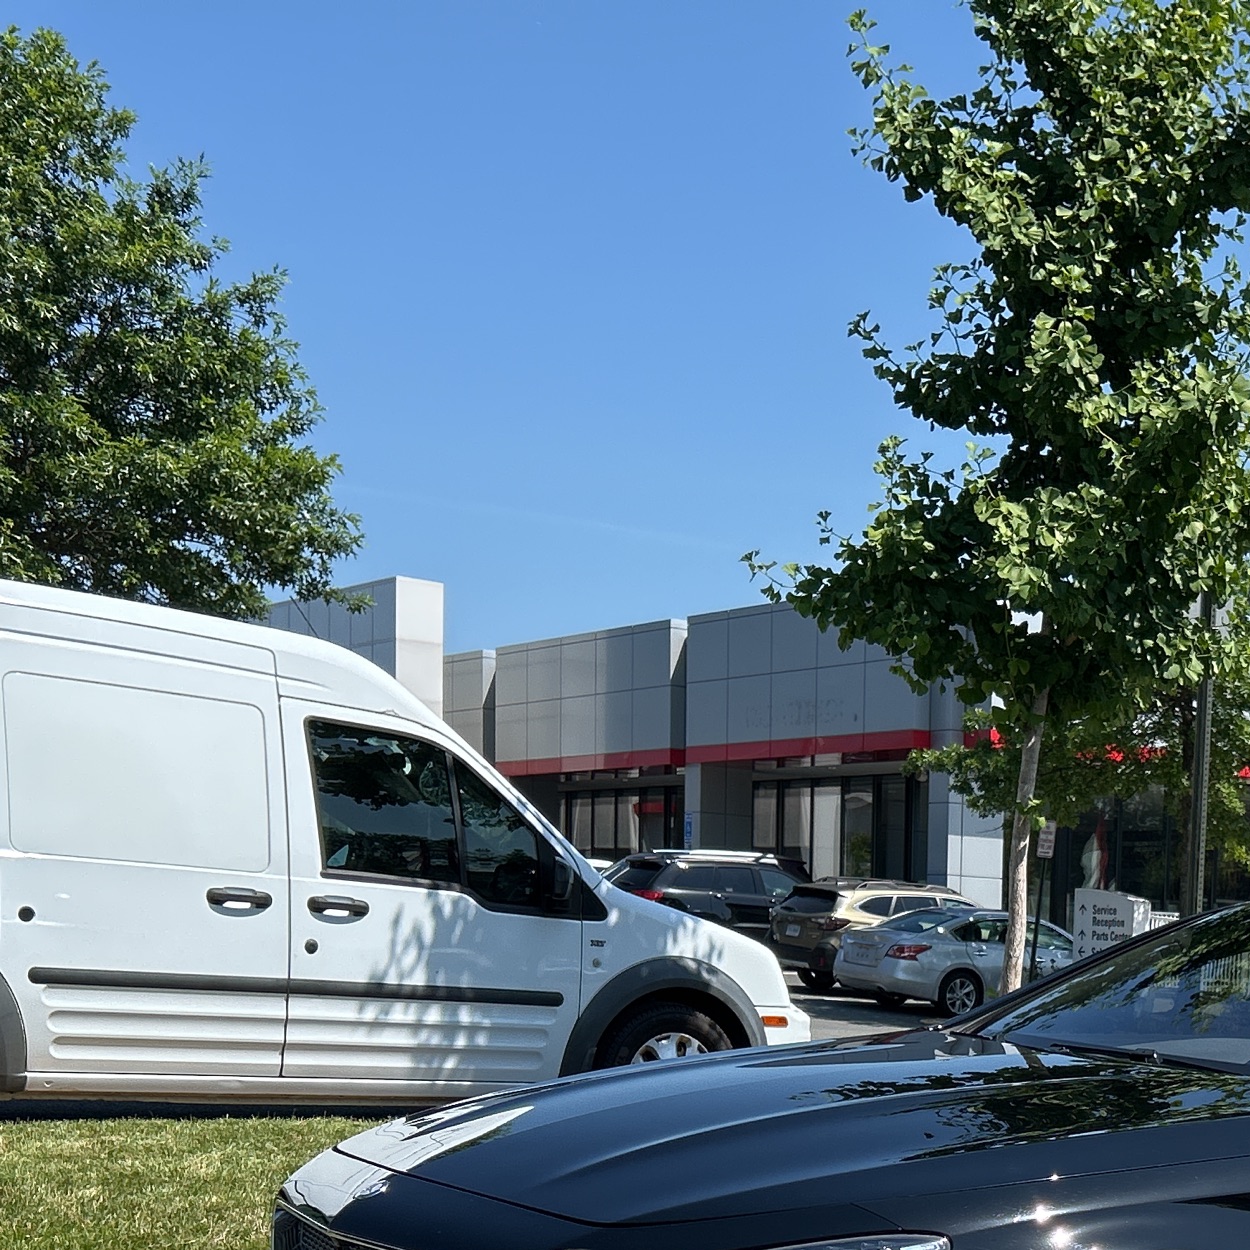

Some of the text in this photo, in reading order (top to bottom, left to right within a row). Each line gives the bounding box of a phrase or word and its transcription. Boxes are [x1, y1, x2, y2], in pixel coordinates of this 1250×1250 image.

[1092, 904, 1117, 916] Service
[1092, 916, 1125, 930] Reception
[1091, 930, 1109, 941] Parts
